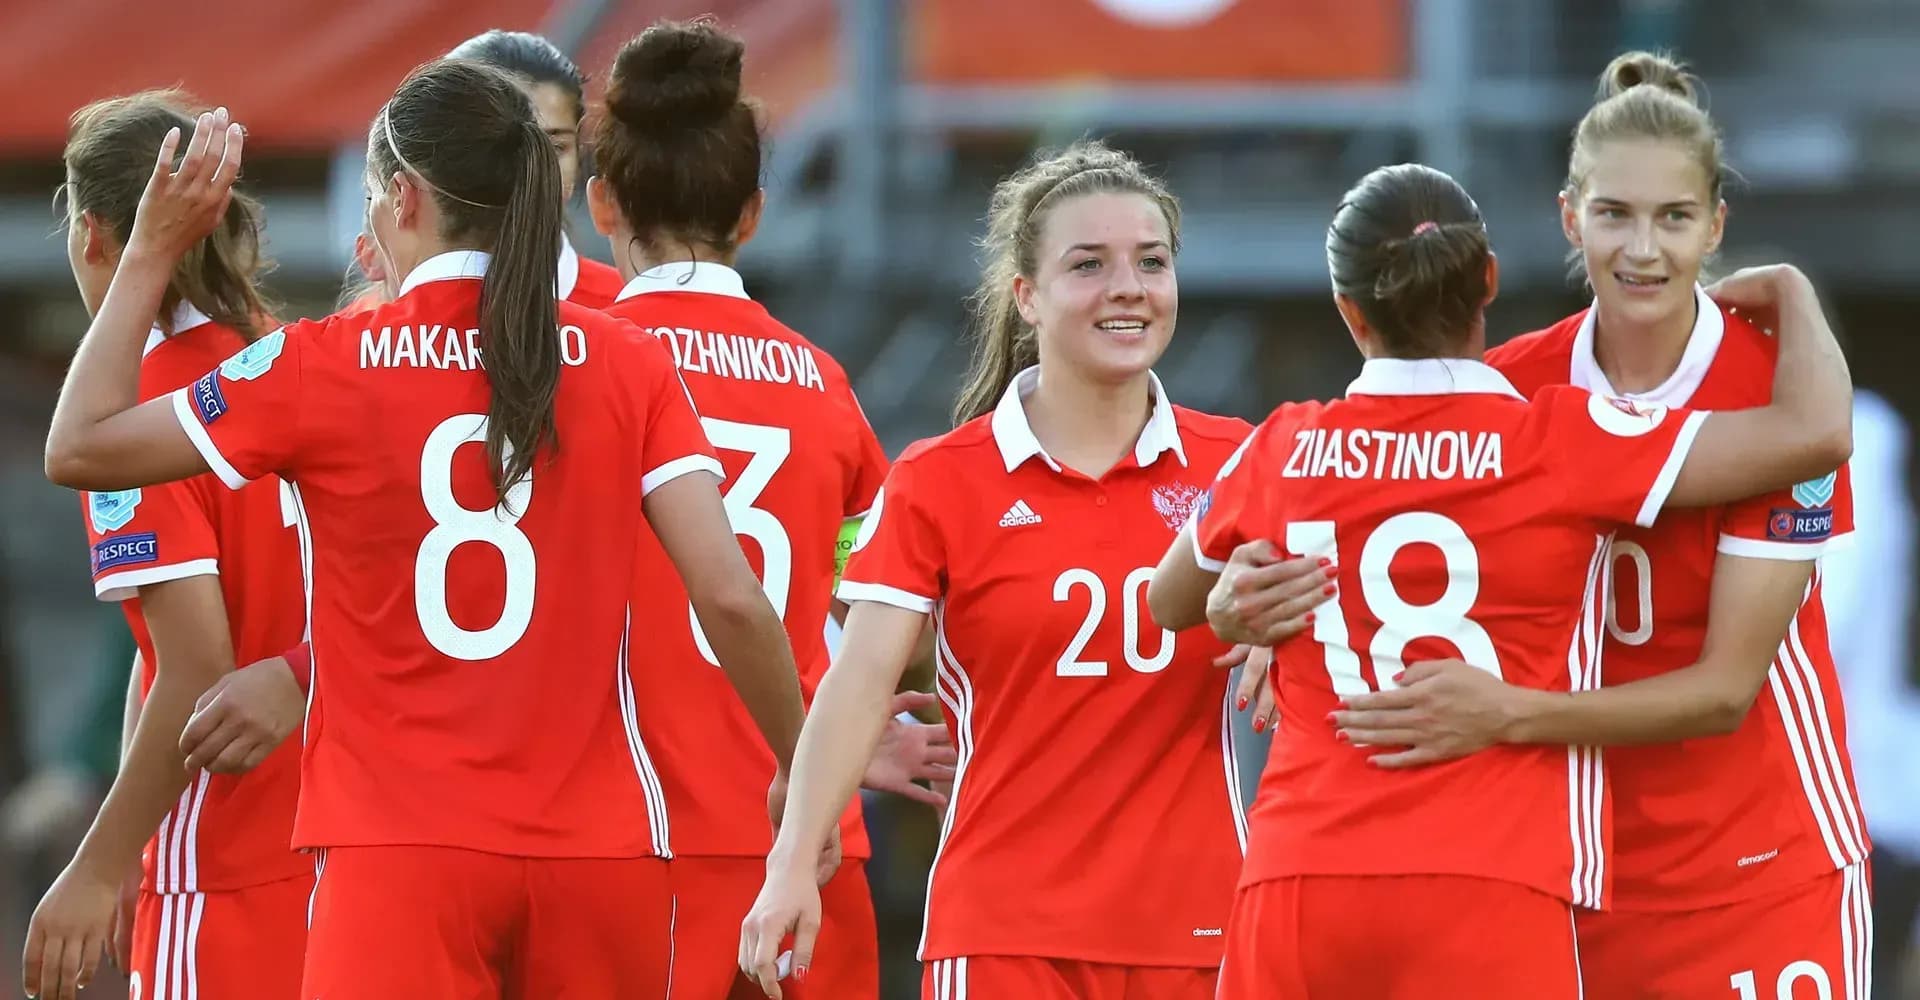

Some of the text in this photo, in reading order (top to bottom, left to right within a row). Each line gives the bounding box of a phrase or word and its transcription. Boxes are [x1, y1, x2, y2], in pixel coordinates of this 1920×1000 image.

[360, 324, 587, 371] MAKARO
[645, 327, 825, 392] OZHNIKOVA
[199, 376, 222, 417] SPECT
[1282, 428, 1503, 480] ZIIASTINOVA
[414, 414, 537, 661] 8
[688, 416, 792, 668] 3
[999, 514, 1042, 527] adidas
[1795, 516, 1832, 533] RESPE
[99, 540, 156, 562] RESPECT
[1053, 567, 1176, 677] 20
[1605, 541, 1653, 646] 0
[1286, 511, 1503, 746] 18
